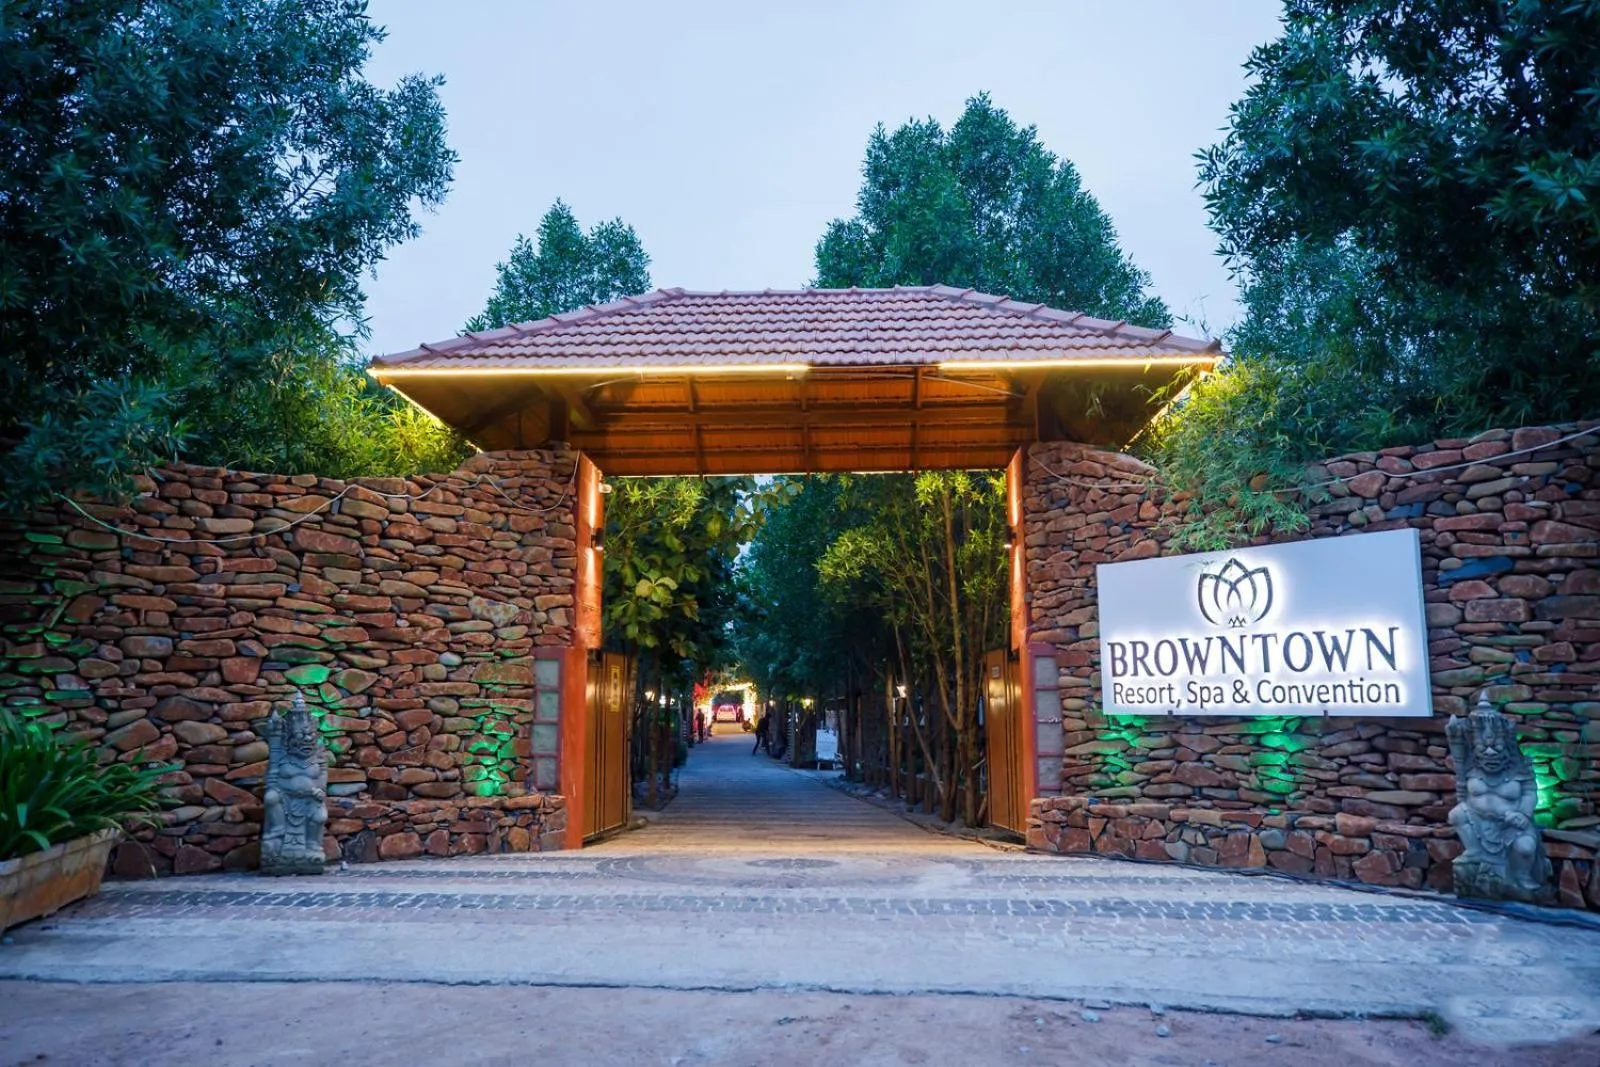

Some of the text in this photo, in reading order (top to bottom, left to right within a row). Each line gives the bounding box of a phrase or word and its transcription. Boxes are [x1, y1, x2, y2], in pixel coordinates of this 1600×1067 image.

[1107, 627, 1399, 677] BROWNTOWN
[1113, 678, 1400, 708] Resort, Spa & Convention
